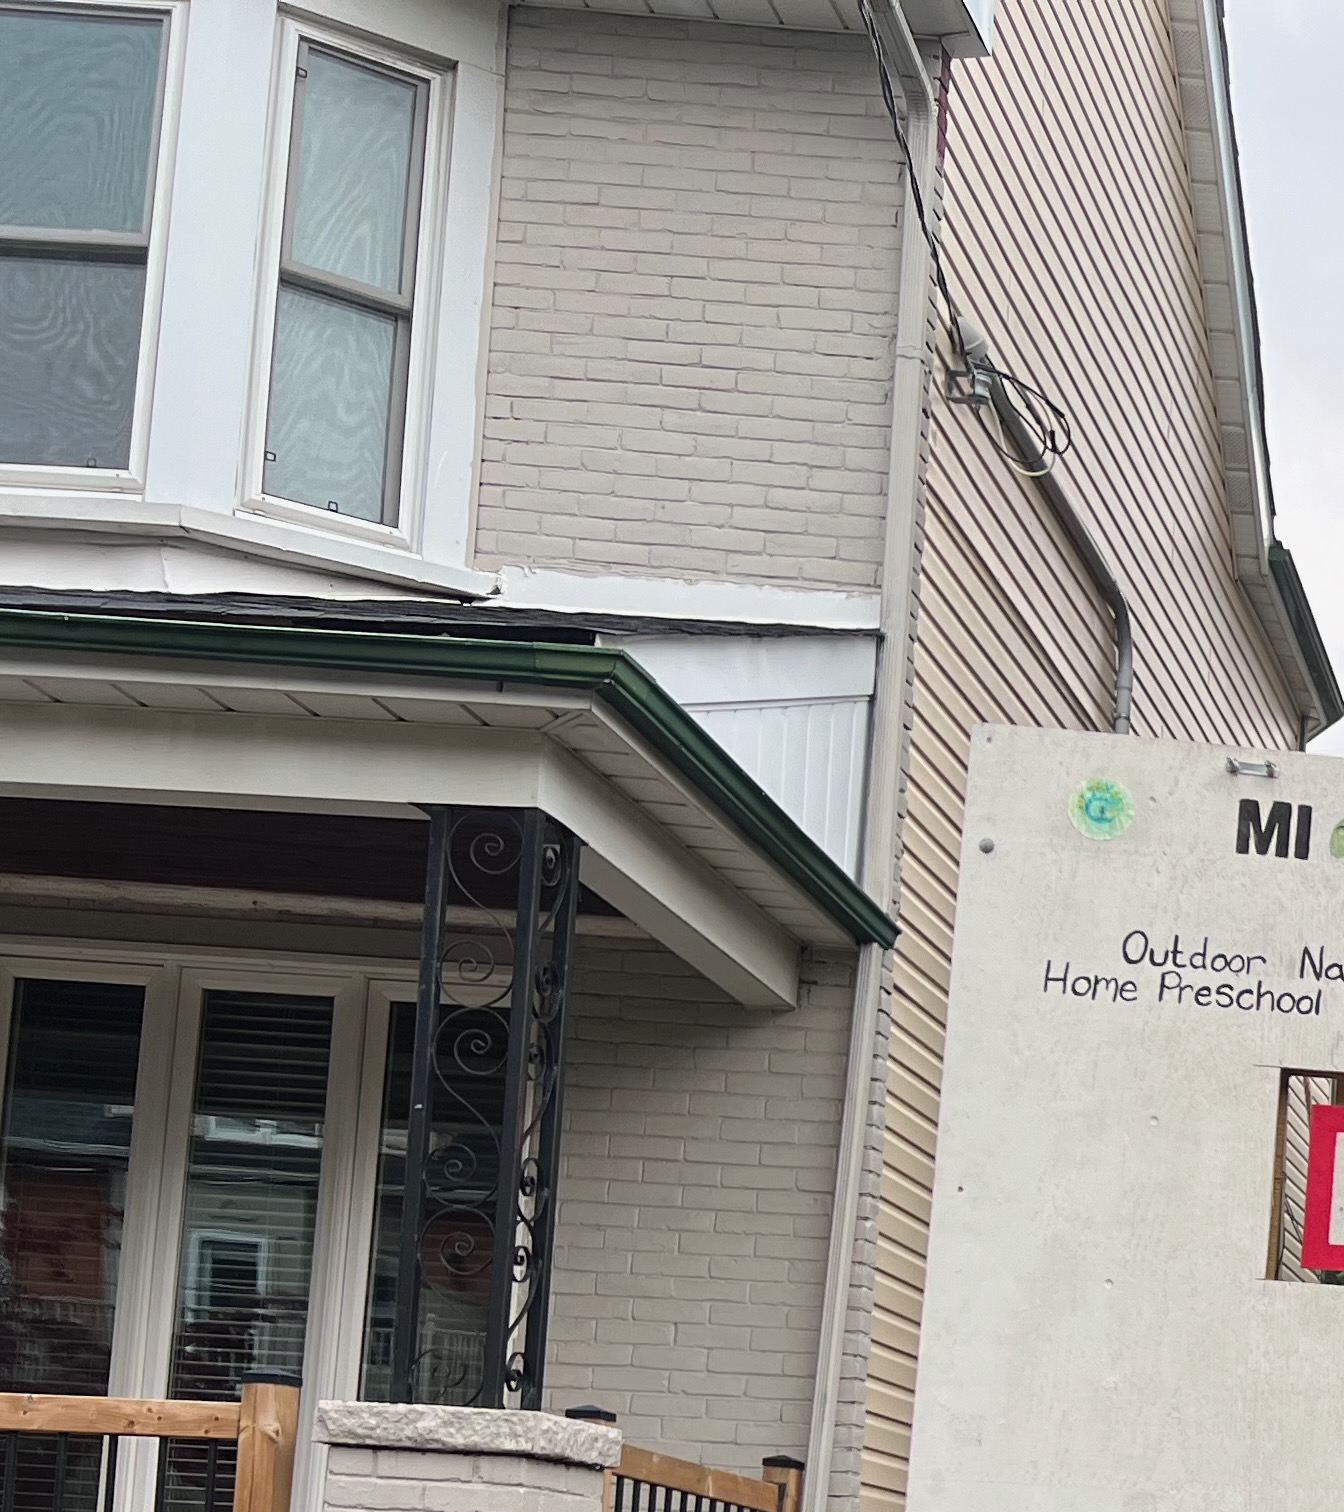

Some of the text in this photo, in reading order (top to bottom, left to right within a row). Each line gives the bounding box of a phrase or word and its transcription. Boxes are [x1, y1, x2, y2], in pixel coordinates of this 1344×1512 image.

[1236, 798, 1312, 860] MI
[1122, 929, 1267, 975] Outdoor
[1043, 959, 1138, 1003] Home
[1158, 970, 1322, 1016] Preschool
